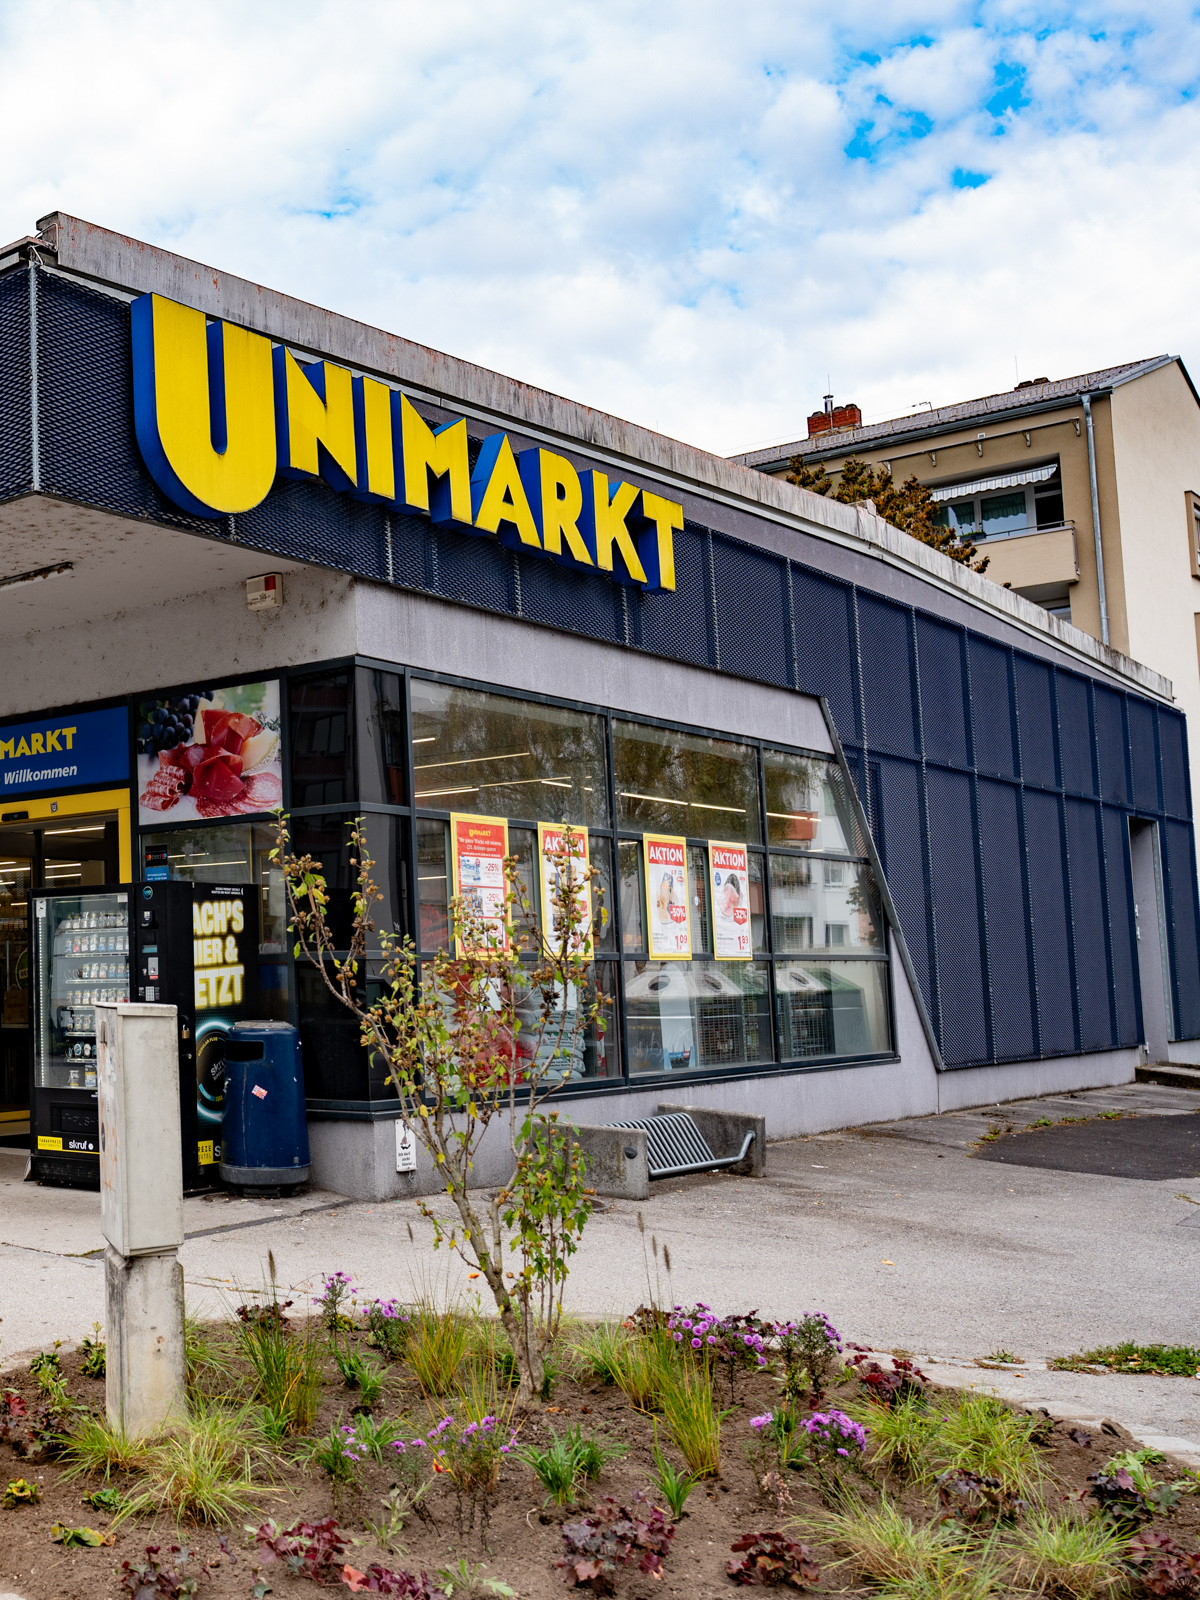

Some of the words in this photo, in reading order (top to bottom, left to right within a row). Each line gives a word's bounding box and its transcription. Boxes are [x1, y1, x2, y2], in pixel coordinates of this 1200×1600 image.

[131, 292, 684, 594] UNIMARKT
[4, 765, 77, 785] Willkommen
[469, 829, 491, 837] UNIMARKT
[649, 846, 683, 862] AKTION
[714, 851, 745, 867] AKTION
[485, 862, 499, 872] -25%
[670, 907, 686, 918] -50%
[733, 911, 747, 920] -32%
[225, 935, 238, 963] &
[68, 1140, 87, 1150] skruf
